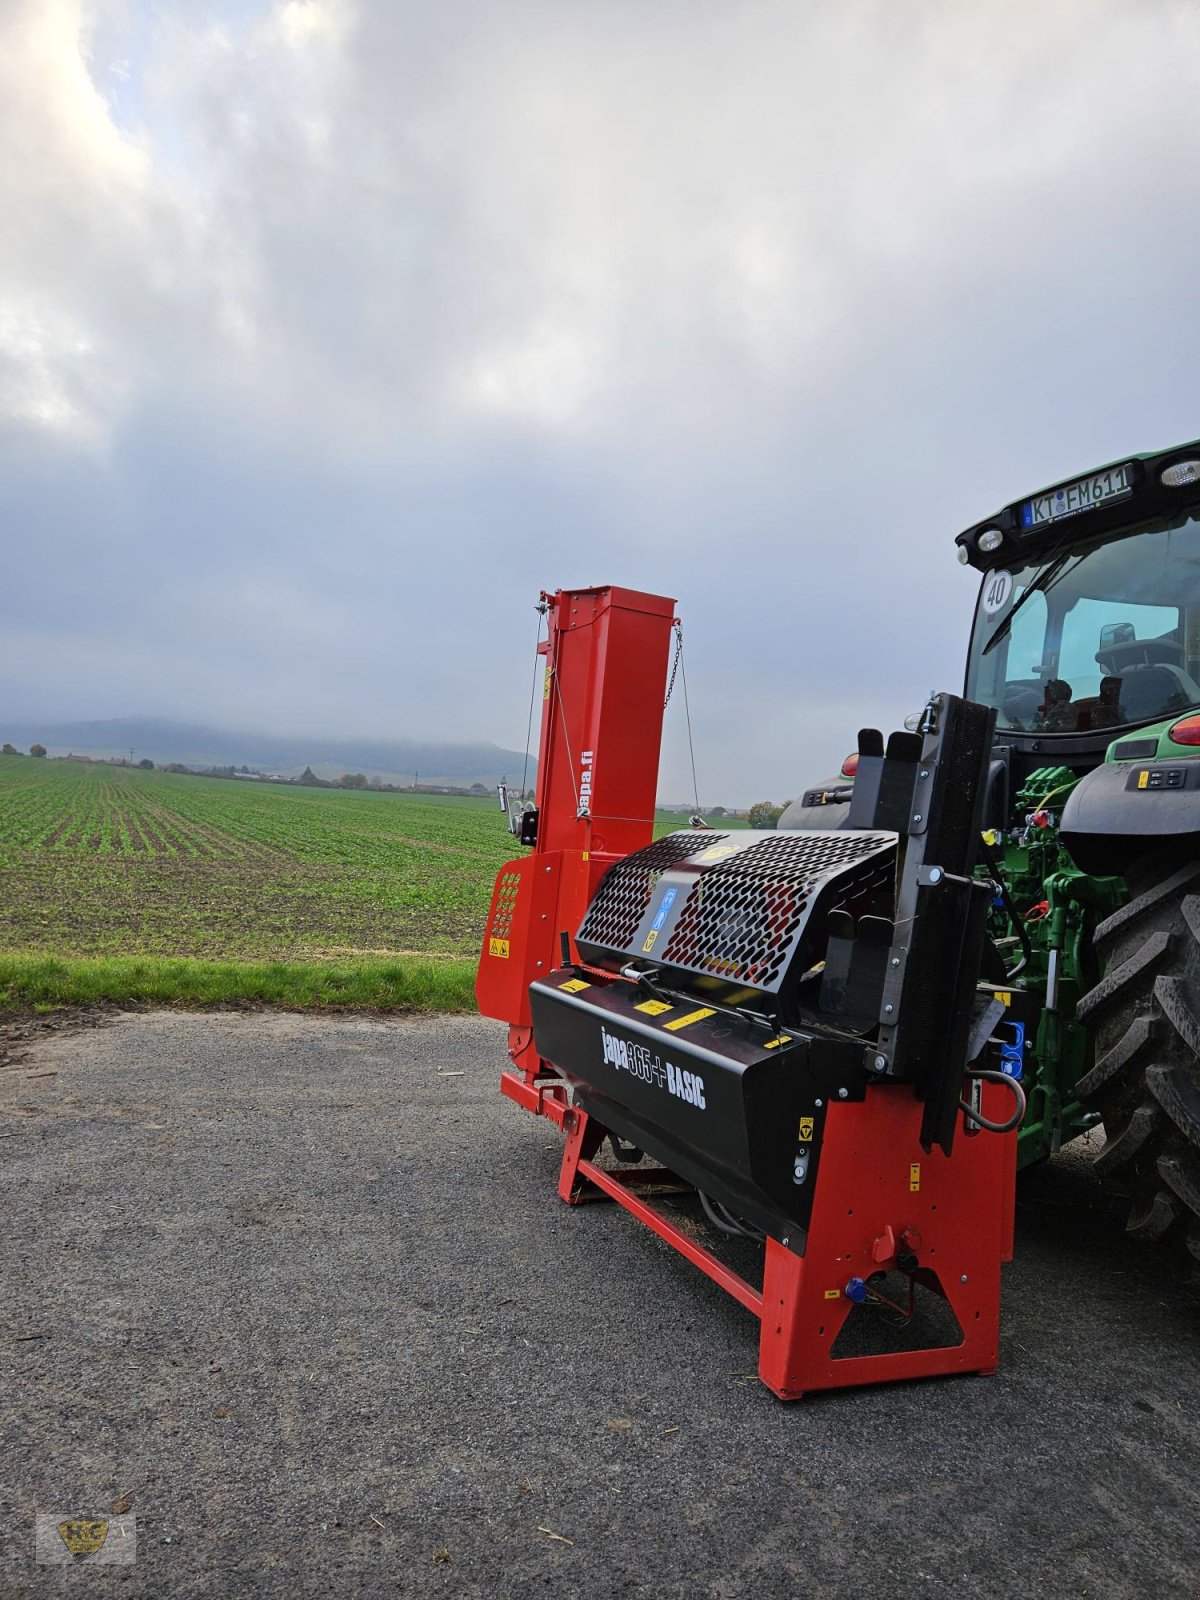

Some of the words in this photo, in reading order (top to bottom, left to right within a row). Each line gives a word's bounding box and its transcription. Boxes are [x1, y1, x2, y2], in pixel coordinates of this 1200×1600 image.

[1033, 495, 1055, 522] KT
[987, 577, 1006, 606] 40
[576, 750, 593, 817] apa.fi
